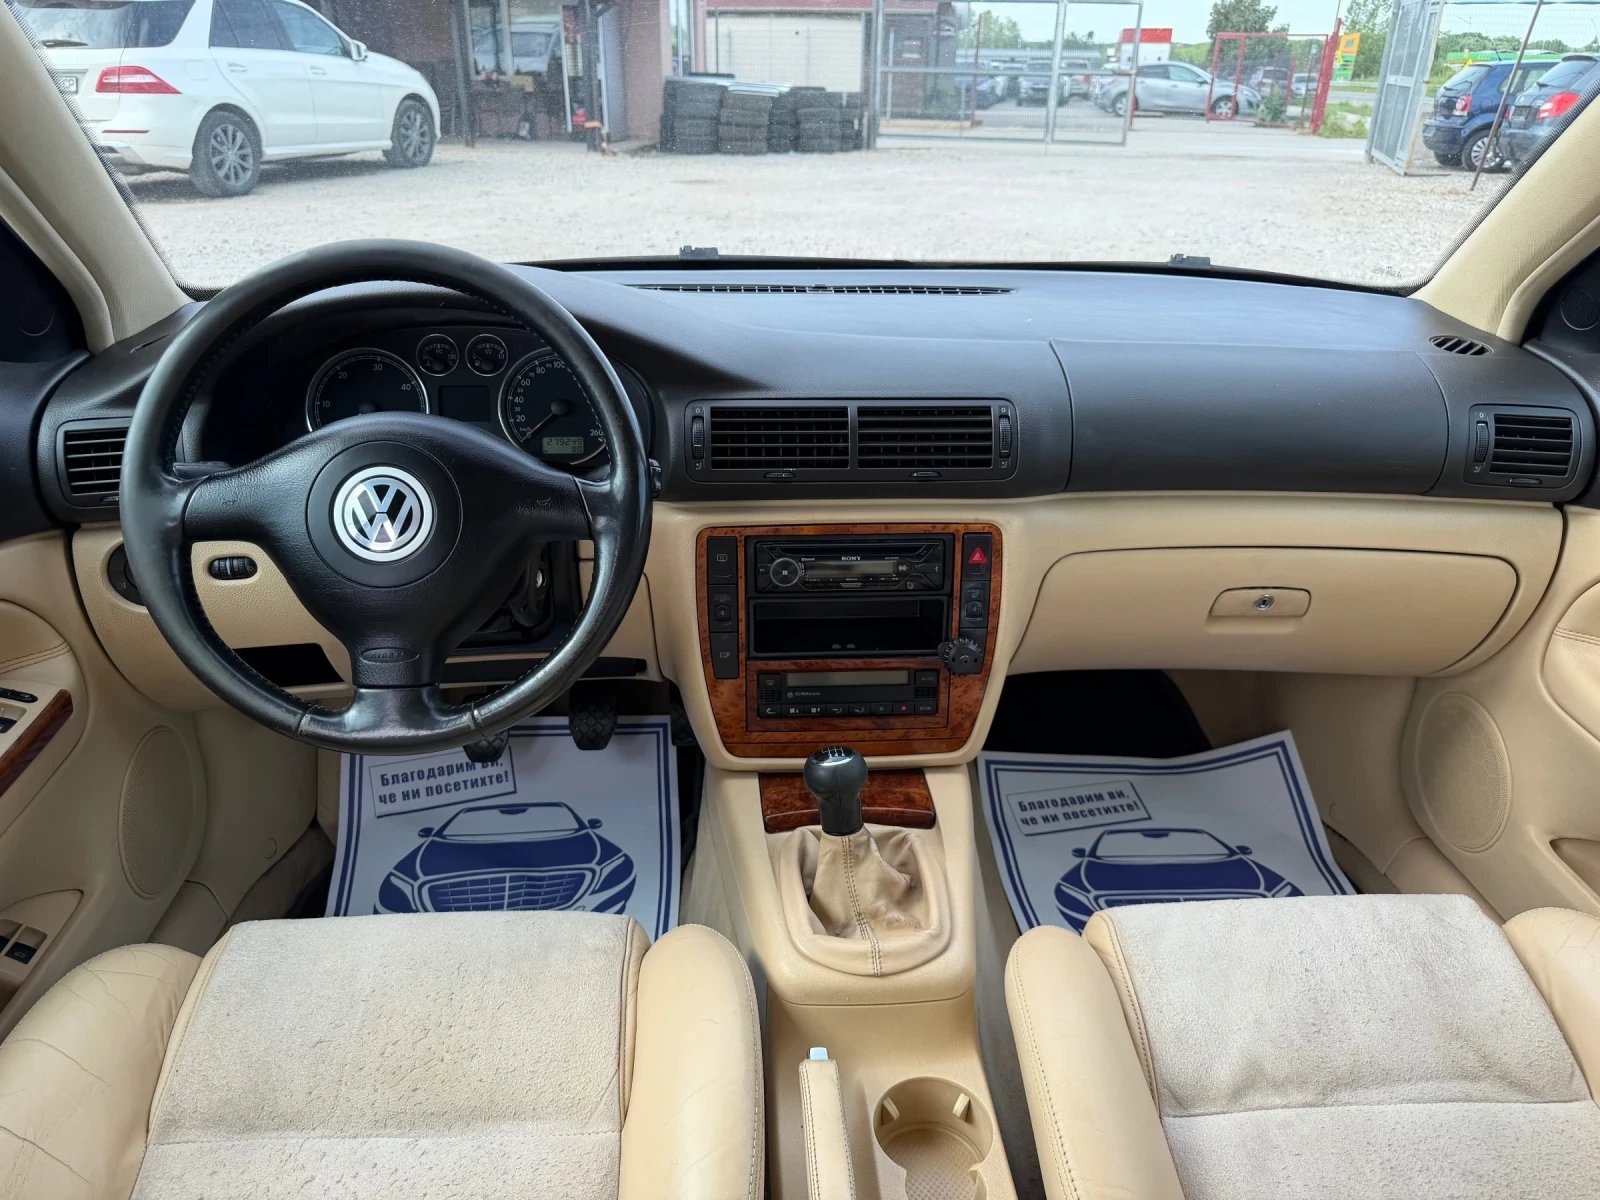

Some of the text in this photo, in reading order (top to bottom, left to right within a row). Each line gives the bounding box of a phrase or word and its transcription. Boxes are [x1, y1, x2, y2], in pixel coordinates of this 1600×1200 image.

[536, 366, 545, 374] 80
[338, 371, 348, 379] 20
[401, 383, 412, 391] 40
[322, 400, 331, 408] 10
[514, 396, 524, 404] 40
[546, 438, 583, 446] 279249
[380, 760, 477, 787] Благодарим
[378, 770, 510, 805] че ни посетихте!
[1018, 791, 1105, 812] Благодарим
[1020, 801, 1142, 827] че ни посетихте!
